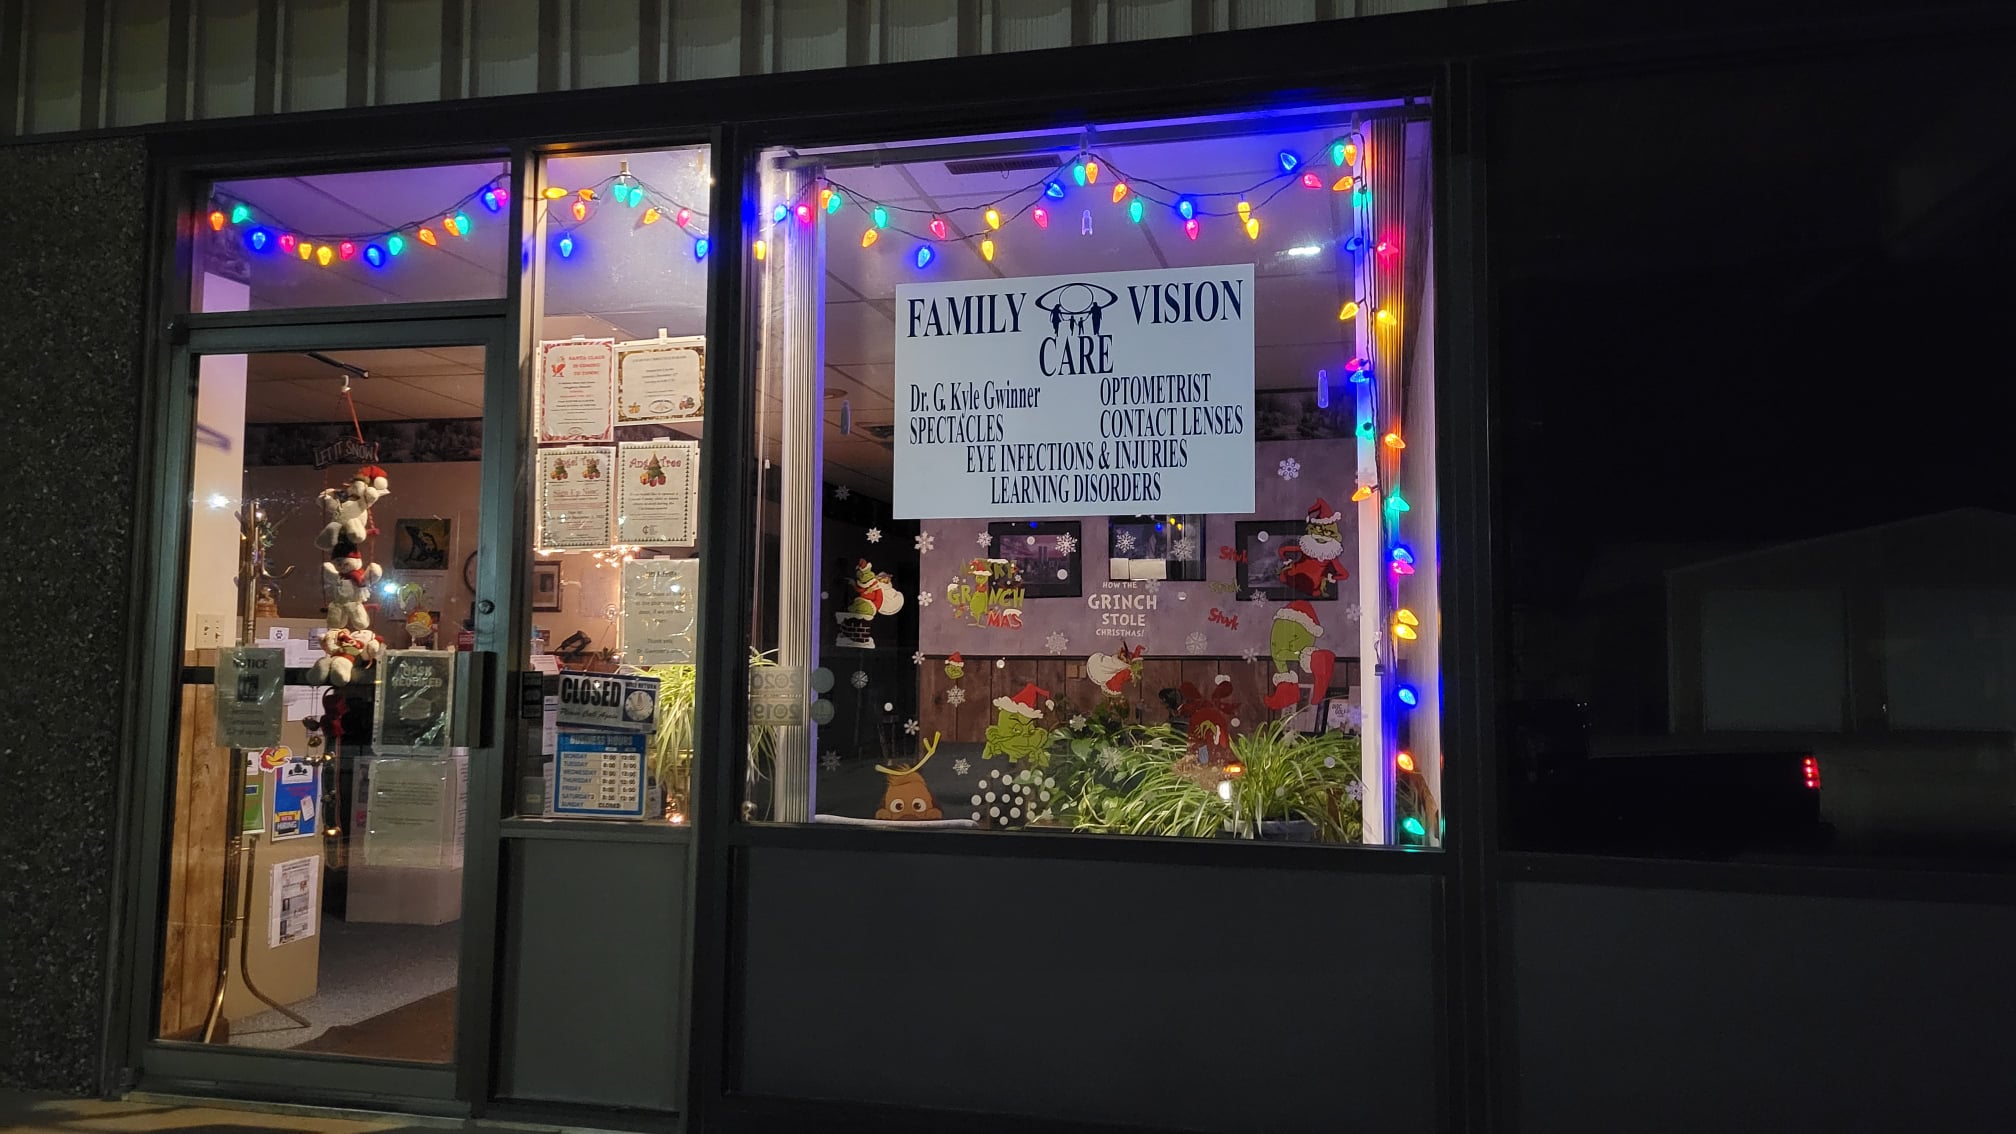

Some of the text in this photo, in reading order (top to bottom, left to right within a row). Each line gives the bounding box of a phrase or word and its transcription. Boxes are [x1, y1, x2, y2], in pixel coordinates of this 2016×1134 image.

[907, 279, 1244, 338] FAMILY VISION
[1039, 334, 1114, 377] CARE
[910, 380, 1041, 418] Dr. G. Kyle Gwinner
[1100, 373, 1212, 406] OPTOMETRIST
[910, 414, 1004, 444] SPECTACLES
[1100, 405, 1244, 438] CONTACT LENSES
[313, 440, 374, 466] LET IT SNOW
[659, 456, 682, 468] Tree
[966, 438, 1189, 473] EYE INFECTIONS & INJURIES
[991, 472, 1162, 504] LEARNING DISORDERS
[947, 584, 1026, 609] GRNCH
[1102, 581, 1139, 589] HOW THE
[1087, 593, 1158, 610] GRINCH
[986, 609, 1024, 630] MAS
[1095, 628, 1145, 637] CHRISTMAS!
[1101, 612, 1146, 627] STOLE
[232, 658, 269, 670] NOTICE
[561, 677, 622, 708] CLOSED
